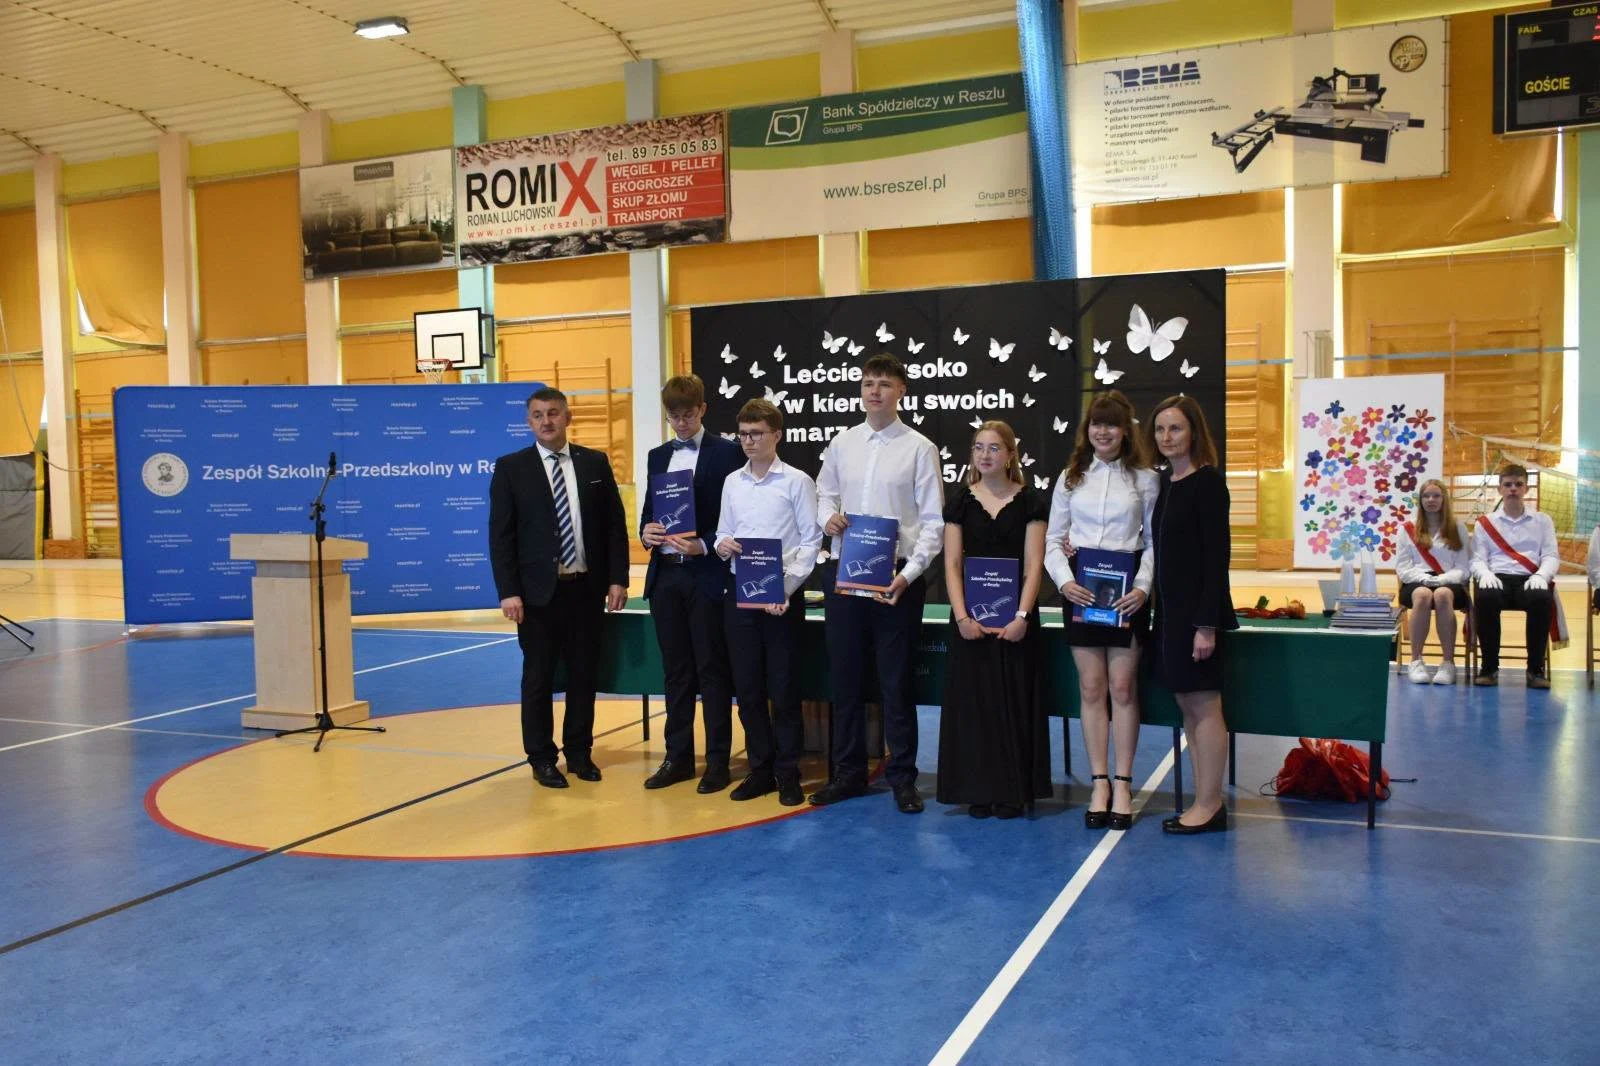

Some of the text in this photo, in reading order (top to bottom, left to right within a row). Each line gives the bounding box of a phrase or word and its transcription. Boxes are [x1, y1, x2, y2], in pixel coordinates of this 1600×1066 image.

[1573, 6, 1598, 16] CZAS
[1518, 25, 1542, 35] FAUL
[1124, 61, 1201, 88] REMA
[1525, 76, 1571, 94] GOŚCIE
[823, 86, 1005, 119] Bank Spółdzielczy w Reszlu
[823, 123, 863, 136] Grupa BPS
[606, 139, 717, 162] tel. 89 755 05 83
[611, 163, 657, 179] WĘGIEL
[671, 157, 717, 172] PELLET
[466, 157, 601, 217] ROMIX
[612, 175, 693, 193] EKOGROSZEK
[823, 174, 946, 199] www.bsreszel.pl
[613, 191, 688, 209] SKUP ZŁOMU
[978, 188, 1028, 201] Grupa BPS
[467, 206, 556, 226] ROMAN LUCHOWSKI
[613, 207, 685, 224] TRANSPORT
[468, 216, 603, 239] www.romix.reszel.pl
[784, 398, 805, 413] w
[202, 465, 262, 483] Zespół
[458, 464, 472, 474] w
